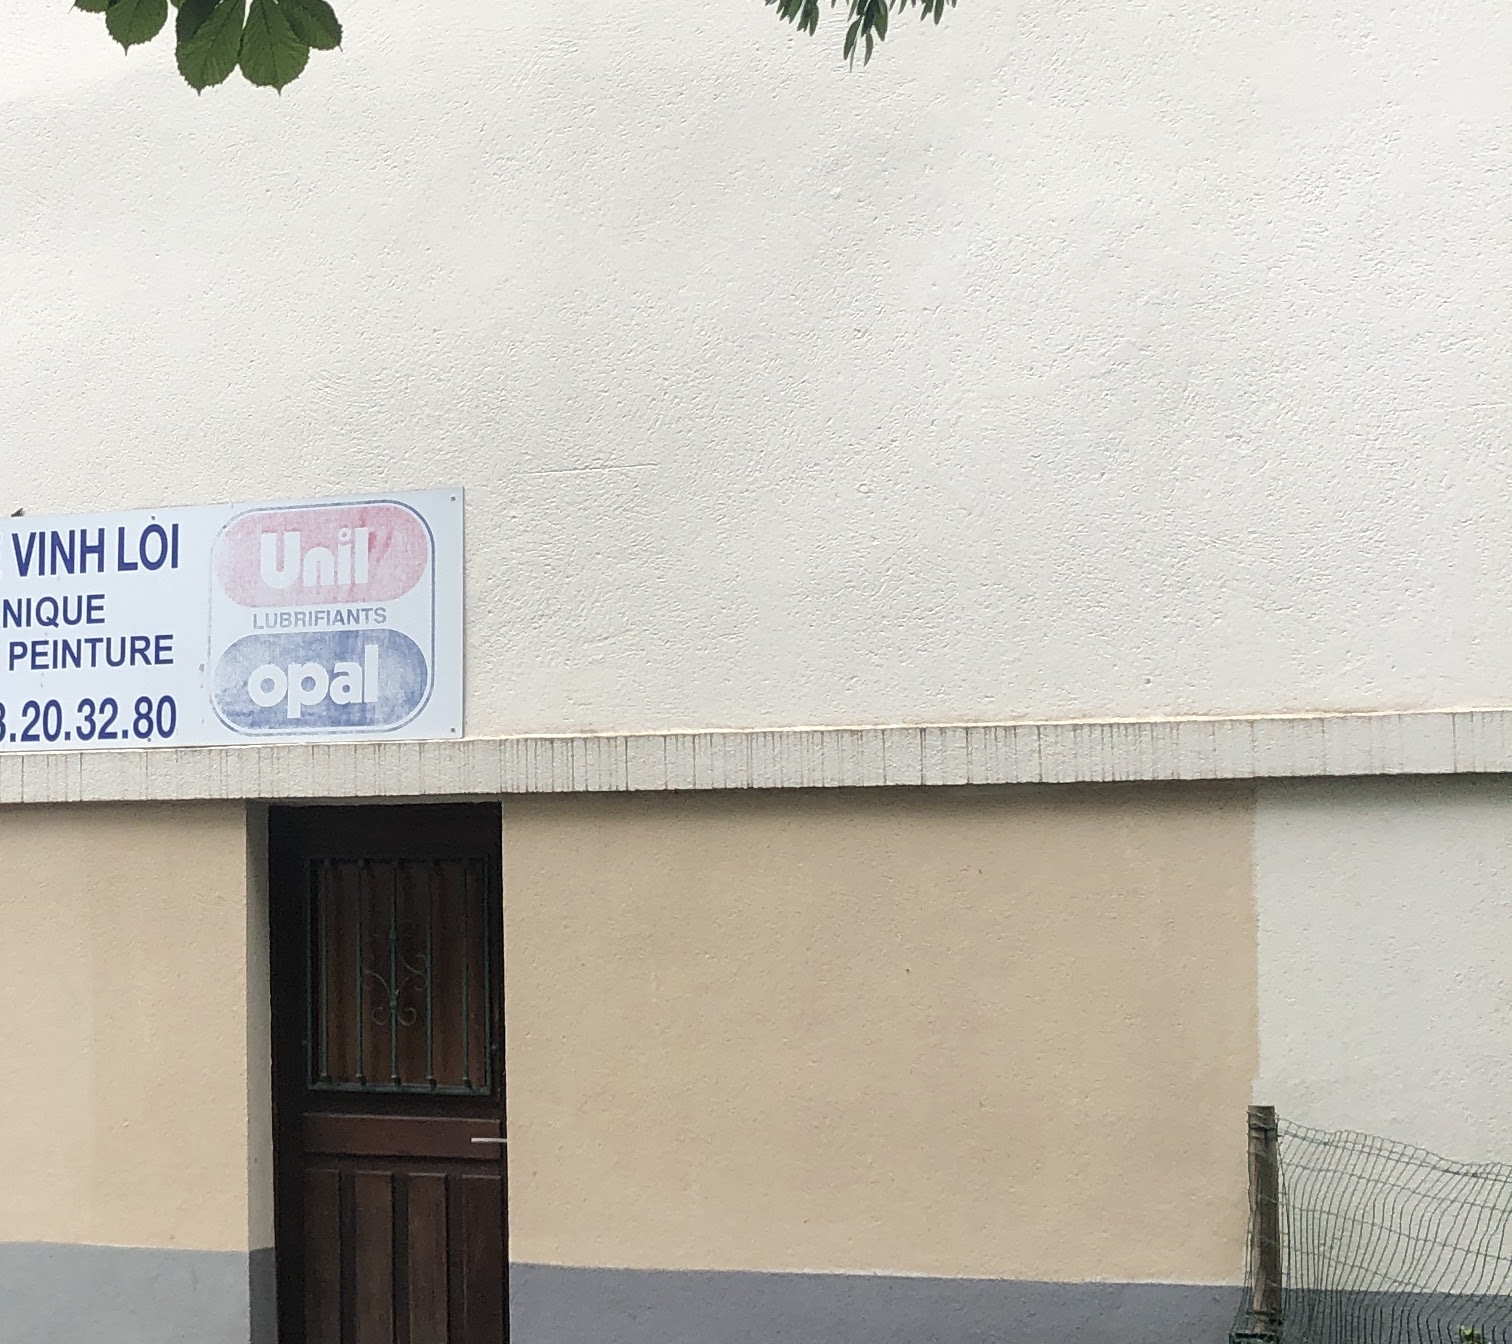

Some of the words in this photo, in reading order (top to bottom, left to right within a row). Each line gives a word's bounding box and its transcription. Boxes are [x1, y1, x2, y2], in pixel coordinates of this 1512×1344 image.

[12, 527, 105, 577] VINH
[118, 523, 179, 572] LOI
[261, 528, 368, 589] Unil
[253, 607, 387, 629] LUBRIFIANTS
[9, 634, 174, 671] PEINTURE
[248, 644, 379, 719] opal
